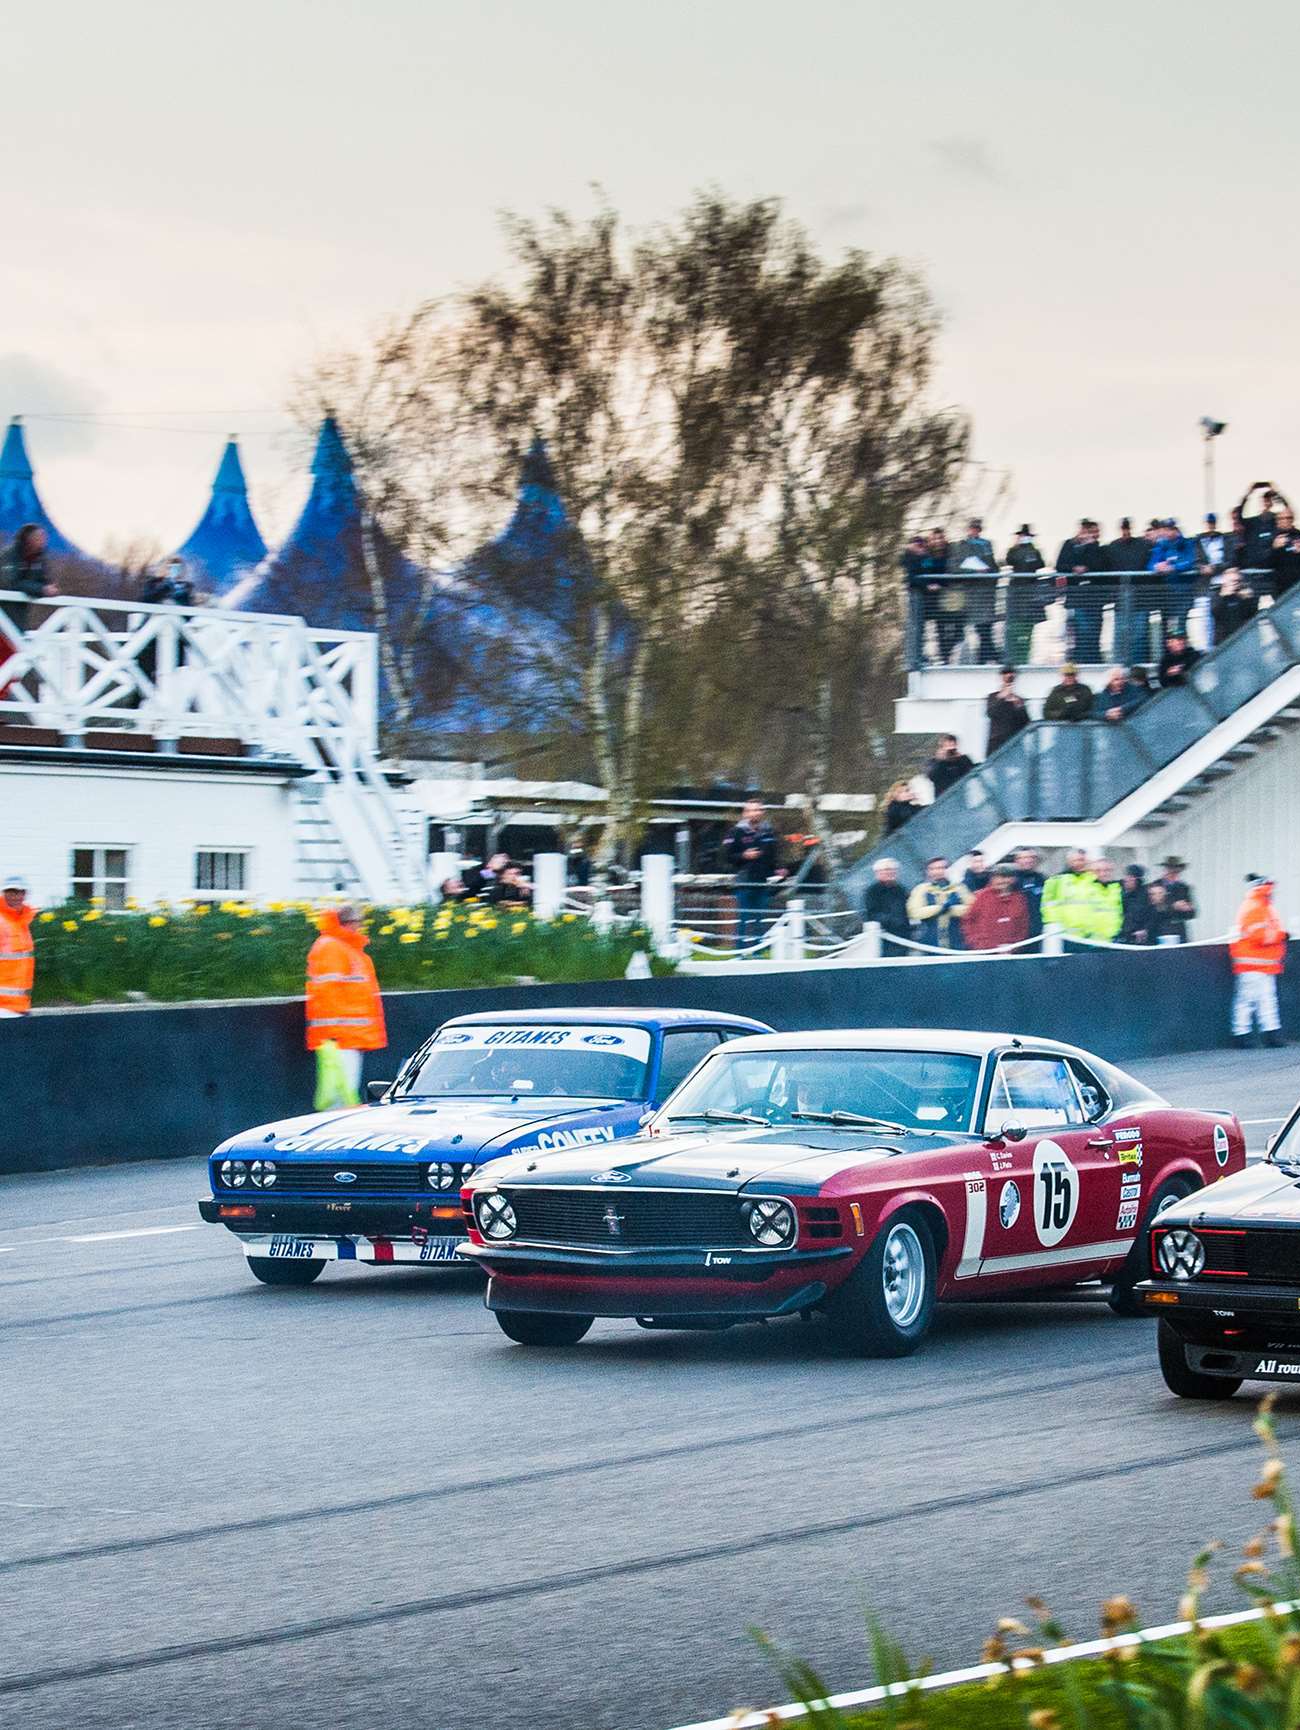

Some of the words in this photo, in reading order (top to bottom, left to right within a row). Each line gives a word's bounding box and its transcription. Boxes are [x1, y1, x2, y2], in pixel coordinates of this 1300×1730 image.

[484, 1031, 572, 1045] GITANES
[968, 1181, 985, 1194] 302
[1040, 1162, 1072, 1231] 15
[269, 1241, 315, 1258] GITANES
[420, 1244, 467, 1260] GITAN
[712, 1257, 732, 1266] TOW
[1212, 1309, 1235, 1318] TOW
[1255, 1360, 1276, 1374] All
